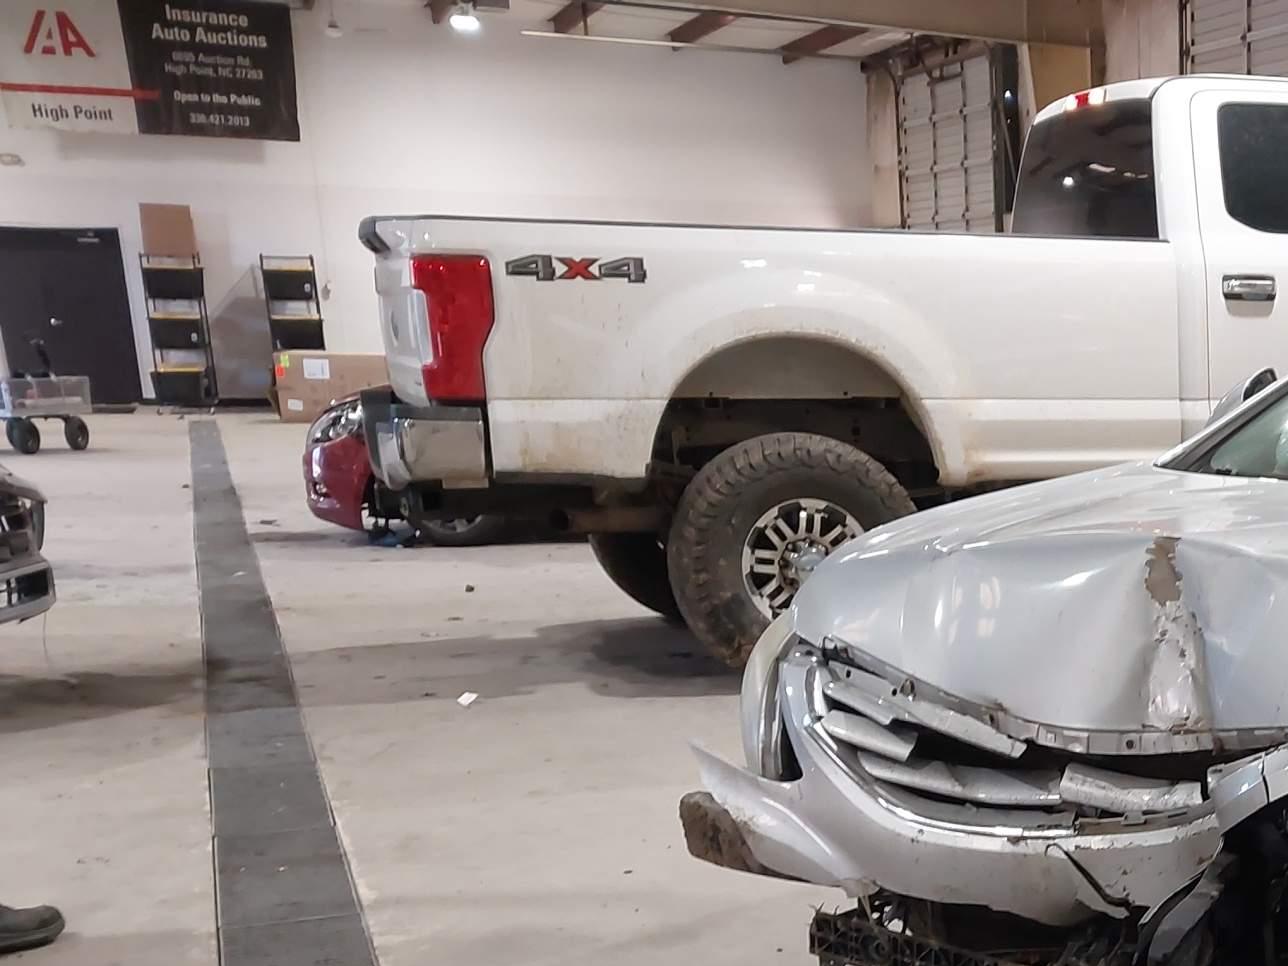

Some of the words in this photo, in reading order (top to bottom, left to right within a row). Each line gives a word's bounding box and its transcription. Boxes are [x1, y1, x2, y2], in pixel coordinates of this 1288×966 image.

[165, 4, 249, 28] Insurance
[151, 23, 191, 42] Auto
[195, 26, 268, 48] Auctions
[164, 62, 188, 76] High
[218, 66, 234, 78] NC
[173, 90, 199, 104] Open
[200, 93, 211, 103] to
[212, 93, 228, 105] the
[230, 94, 261, 106] Public
[32, 103, 70, 121] High
[74, 105, 113, 121] Point
